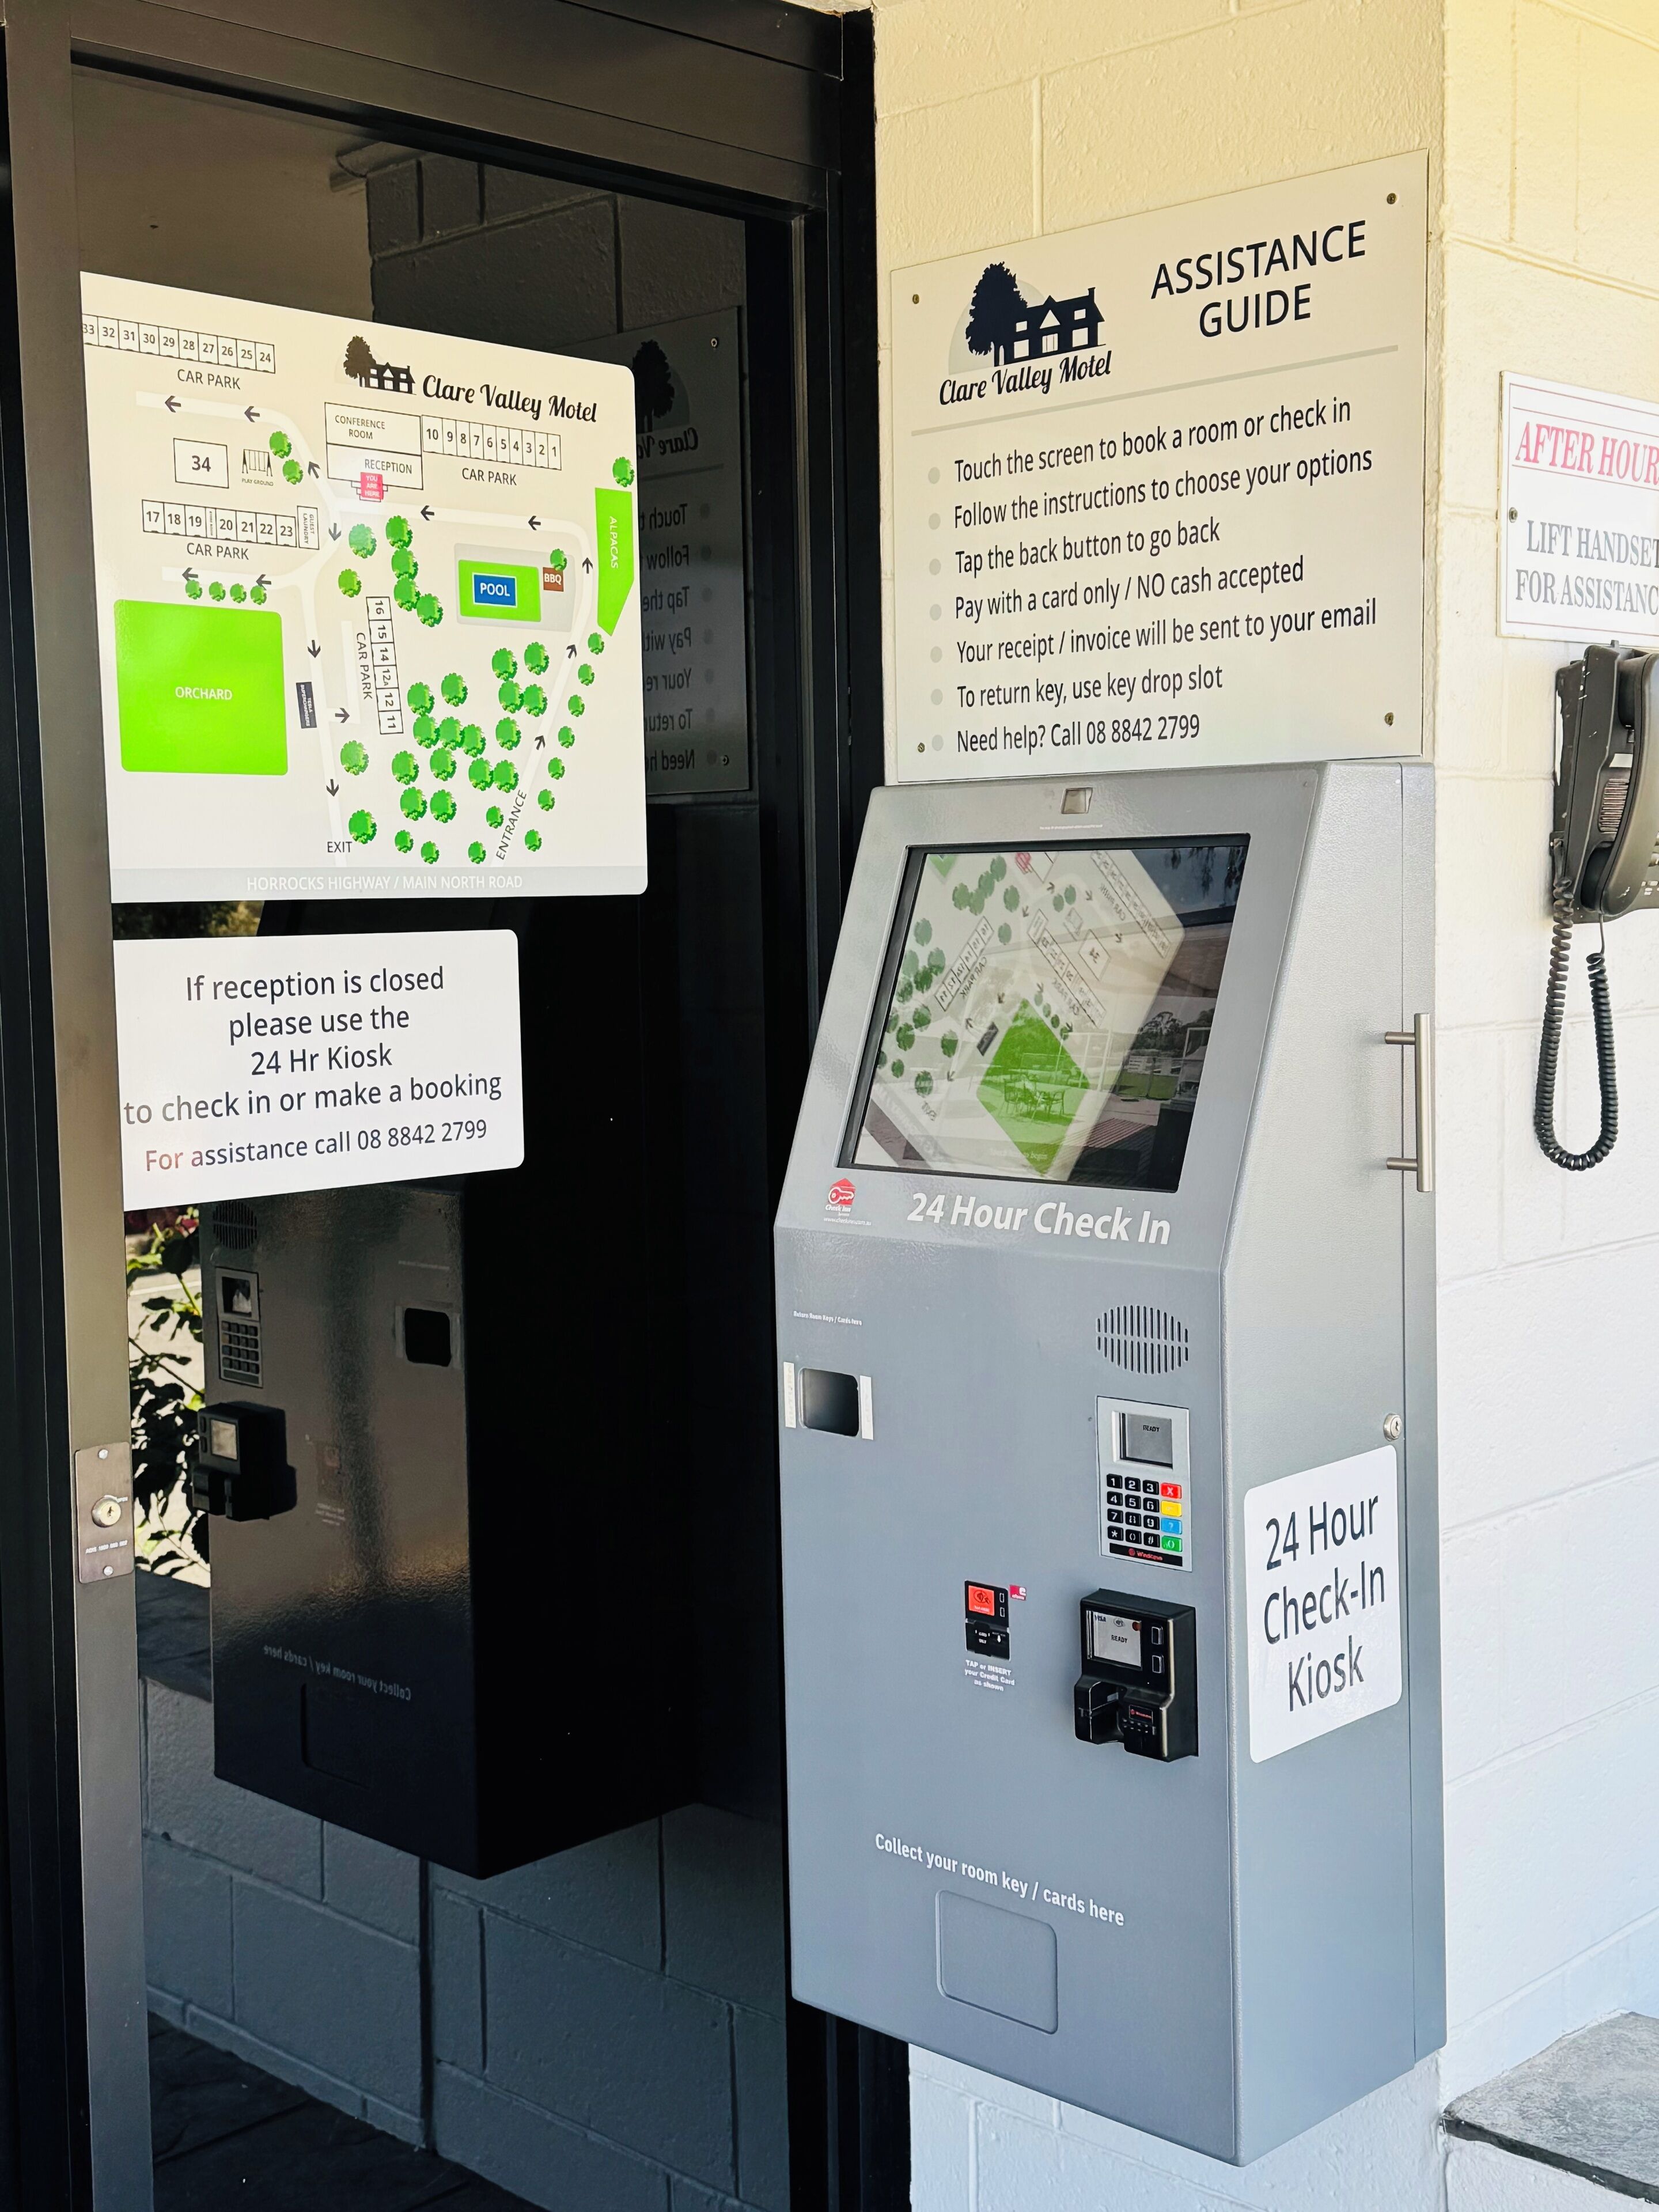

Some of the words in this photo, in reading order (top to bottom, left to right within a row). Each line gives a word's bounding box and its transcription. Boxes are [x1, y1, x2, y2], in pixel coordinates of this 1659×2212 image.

[1151, 220, 1365, 299] ASSISTANCE
[1200, 283, 1310, 337] GUIDE
[177, 369, 203, 384] CAR
[208, 373, 240, 390] PARK
[423, 375, 475, 403] Clare
[480, 384, 541, 421] Valley
[549, 395, 597, 422] Motel
[940, 380, 987, 405] Clare
[992, 366, 1052, 395] Valley
[1059, 350, 1112, 383] Motel
[335, 415, 385, 429] CONFERENCE
[349, 429, 373, 440] ROOM
[955, 453, 1001, 482] Touch
[1007, 449, 1033, 474] the
[1039, 444, 1093, 469] screen
[1099, 438, 1116, 460] to
[1123, 426, 1166, 456] book
[1173, 430, 1181, 448] a
[1190, 421, 1237, 446] room
[1244, 415, 1264, 437] or
[1271, 399, 1326, 433] check
[1334, 397, 1350, 423] in
[191, 455, 211, 472] 34
[365, 459, 412, 474] RECEPTION
[1516, 422, 1595, 474] AFTER
[1598, 436, 1659, 487] HOUR
[463, 468, 484, 482] CAR
[488, 471, 517, 486] PARK
[955, 502, 1006, 528] Follow
[1012, 495, 1038, 520] the
[1044, 482, 1145, 516] instructions
[1151, 479, 1169, 500] to
[1176, 470, 1240, 497] choose
[1246, 462, 1290, 495] your
[1297, 449, 1372, 486] options
[187, 542, 212, 556] CAR
[217, 545, 249, 560] PARK
[609, 516, 619, 569] ALPACAS
[956, 551, 982, 578] Tap
[988, 545, 1014, 569] the
[1020, 538, 1058, 566] back
[1063, 535, 1120, 560] button
[1127, 531, 1144, 552] to
[1150, 529, 1171, 556] go
[1178, 516, 1219, 546] back
[1527, 520, 1572, 557] LIFT
[1577, 527, 1659, 569] HANDSET
[480, 582, 510, 597] POOL
[544, 573, 562, 585] BBQ
[956, 597, 983, 624] Pay
[987, 589, 1021, 615] with
[1028, 593, 1036, 611] a
[1043, 582, 1077, 609] card
[1084, 578, 1120, 609] only
[1138, 573, 1165, 599] NO
[1171, 567, 1211, 595] cash
[1218, 555, 1303, 593] accepted
[1516, 569, 1556, 605] FOR
[1560, 575, 1659, 615] ASSISTANC
[357, 632, 368, 661] CAR
[957, 641, 993, 663] Your
[999, 633, 1054, 663] receipt
[1071, 626, 1130, 653] invoice
[1136, 619, 1165, 646] will
[1173, 618, 1194, 643] be
[1200, 616, 1240, 641] sent
[1245, 615, 1264, 636] to
[1270, 611, 1315, 642] your
[1321, 597, 1376, 629] email
[175, 685, 233, 702] ORCHARD
[360, 664, 373, 700] PARK
[957, 686, 975, 707] To
[980, 685, 1029, 706] return
[1036, 679, 1066, 707] key,
[1073, 680, 1101, 699] use
[1108, 672, 1136, 702] key
[1142, 669, 1182, 699] drop
[1189, 664, 1222, 690] slot
[958, 727, 997, 752] Need
[1004, 725, 1046, 755] help?
[1051, 721, 1080, 747] Call
[1087, 721, 1105, 744] 08
[1112, 718, 1152, 743] 8842
[1158, 714, 1199, 740] 2799
[327, 840, 352, 855] EXIT
[495, 789, 528, 862] ENTRANCE
[246, 876, 324, 891] HORROCKS
[327, 876, 391, 890] HIGHWAY
[402, 875, 437, 889] MAIN
[440, 875, 486, 889] NORTH
[488, 875, 523, 889] ROAD
[187, 975, 204, 1001] If
[214, 972, 334, 1005] reception
[344, 970, 361, 993] is
[370, 965, 443, 992] closed
[230, 1013, 312, 1046] please
[321, 1013, 362, 1032] use
[370, 1005, 409, 1029] the
[251, 1051, 281, 1075] 24
[290, 1049, 319, 1072] Hr
[328, 1043, 392, 1070] Kiosk
[124, 1103, 151, 1124] to
[162, 1092, 240, 1121] check
[248, 1090, 270, 1114] in
[281, 1092, 306, 1111] or
[316, 1081, 381, 1108] make
[389, 1085, 401, 1102] a
[411, 1073, 501, 1100] booking
[146, 1150, 183, 1171] For
[192, 1141, 307, 1166] assistance
[316, 1131, 350, 1154] call
[358, 1130, 381, 1150] 08
[388, 1124, 435, 1147] 8842
[442, 1119, 486, 1142] 2799
[907, 1192, 945, 1224] 24
[949, 1194, 1028, 1232] Hour
[1033, 1202, 1132, 1241] Check
[1138, 1209, 1171, 1245] In
[1265, 1510, 1300, 1571] 24
[1309, 1495, 1379, 1555] Hour
[1264, 1560, 1385, 1645] Check-In
[1111, 1634, 1128, 1643] READY
[965, 1659, 978, 1668] TAP
[1288, 1634, 1365, 1712] Kiosk
[875, 1832, 923, 1862] Collect
[926, 1850, 958, 1873] your
[961, 1862, 998, 1886] room
[1001, 1870, 1028, 1899] key
[1043, 1888, 1086, 1914] cards
[1089, 1899, 1125, 1926] here
